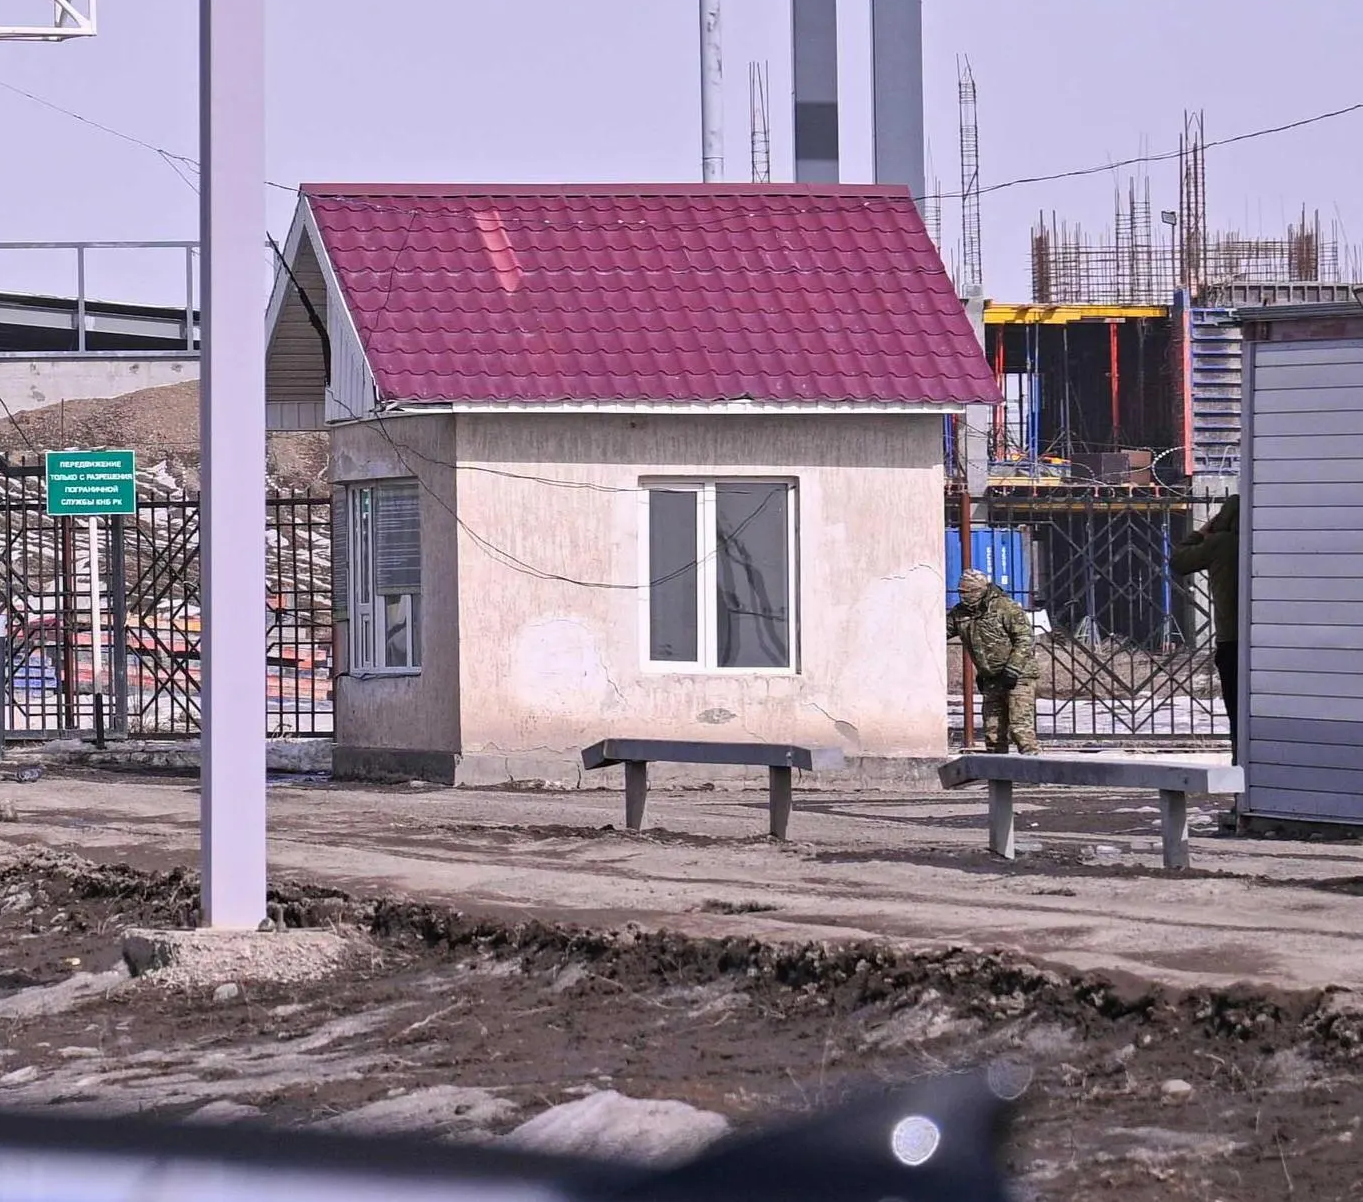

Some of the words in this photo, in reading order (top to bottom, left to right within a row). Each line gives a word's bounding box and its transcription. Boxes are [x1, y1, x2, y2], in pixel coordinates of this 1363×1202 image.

[59, 460, 122, 469] ПЕРЕДВИЖЕНИЕ
[49, 473, 78, 481] ТОЛЬКО
[79, 473, 85, 481] С
[86, 473, 133, 481] РАЗРЕШЕНИЯ
[64, 485, 119, 494] ПОГРАНИЧНОЙ
[60, 498, 95, 506] СЛУЖБЫ
[112, 498, 123, 506] РК
